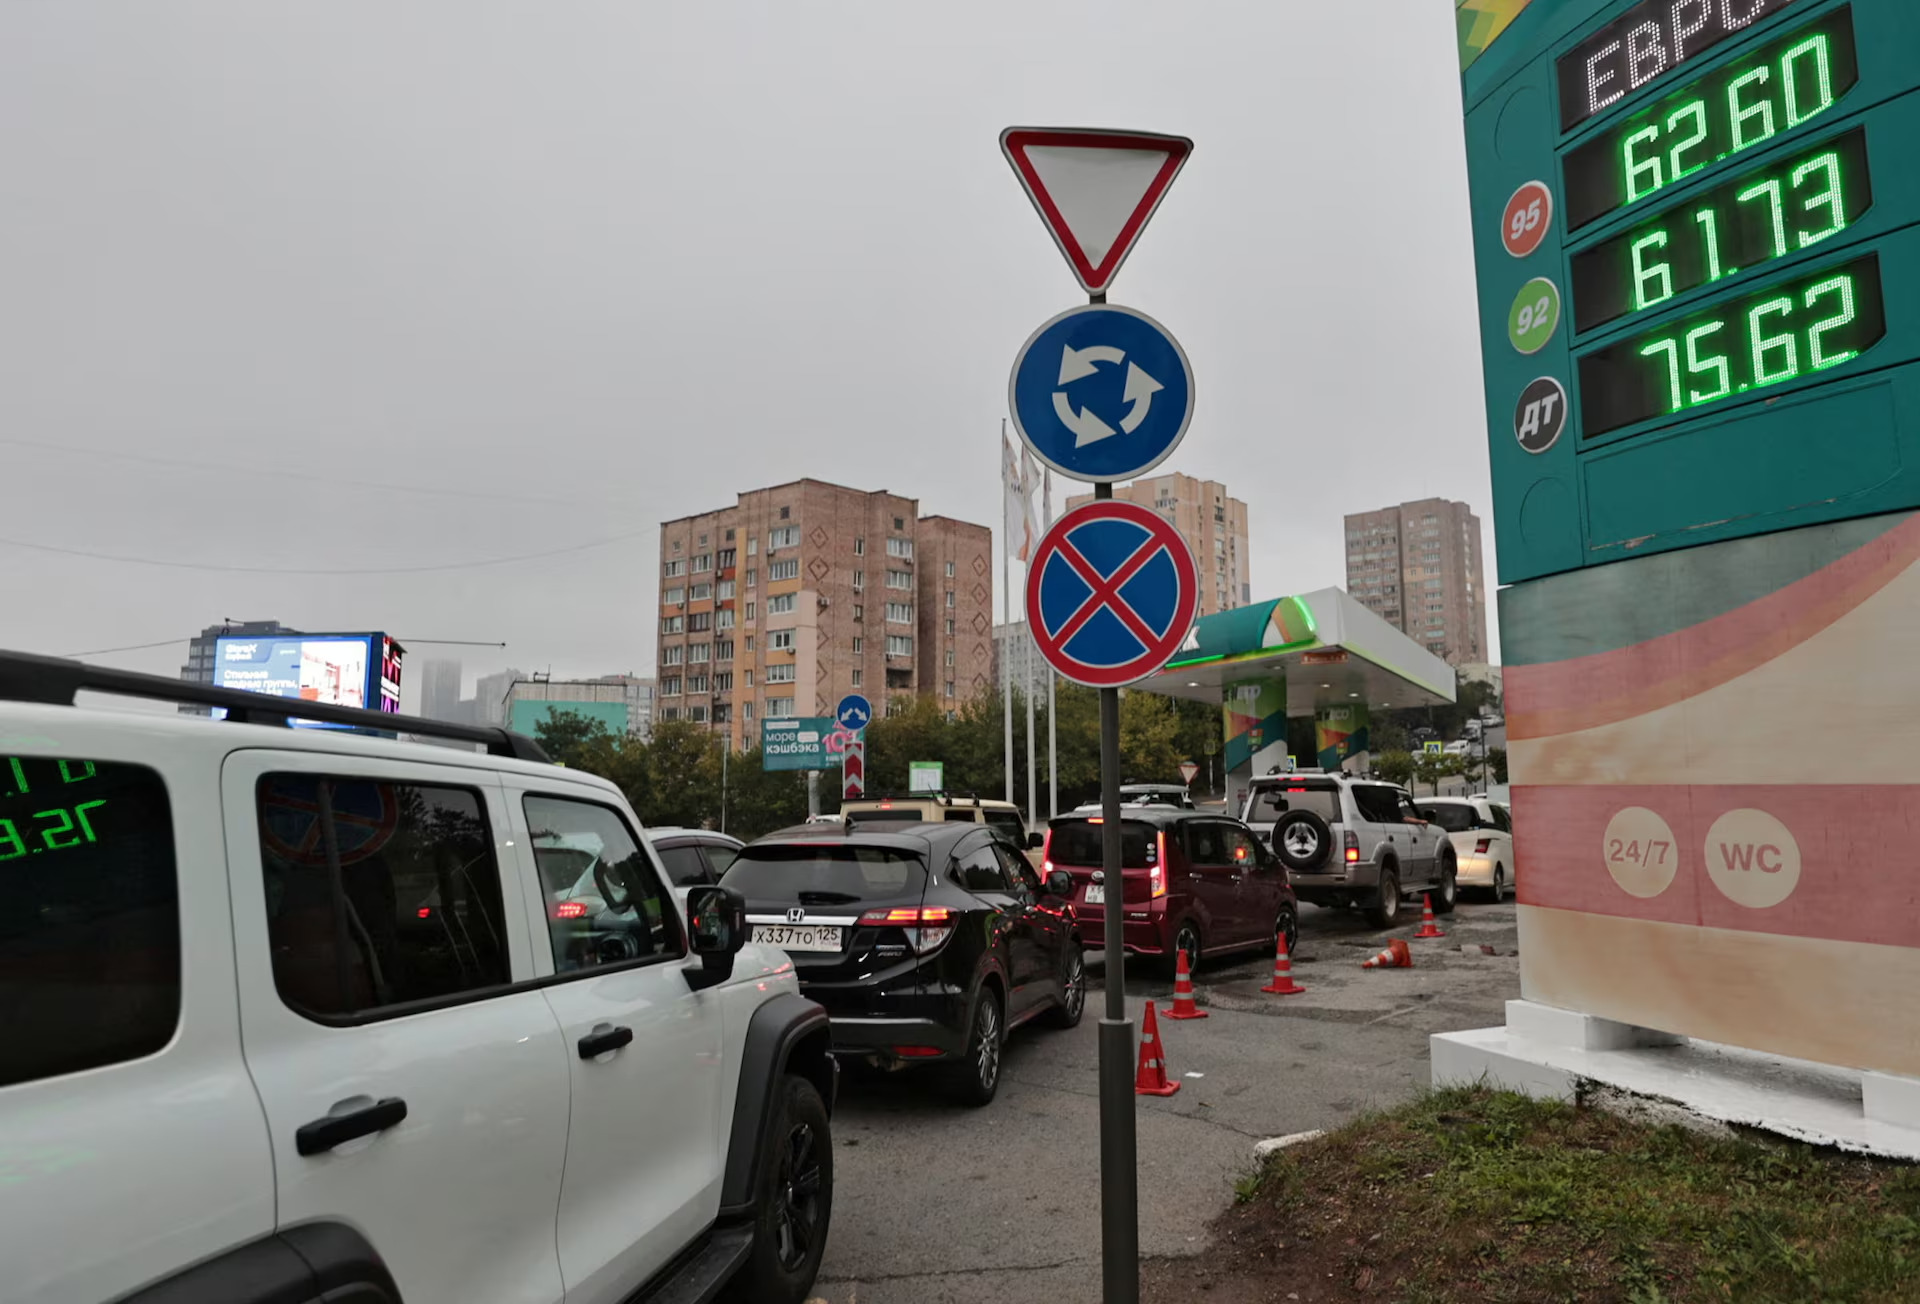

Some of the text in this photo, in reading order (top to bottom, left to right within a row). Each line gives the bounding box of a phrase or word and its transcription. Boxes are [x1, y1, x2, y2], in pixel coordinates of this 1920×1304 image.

[1624, 34, 1833, 203] 62.60
[1511, 198, 1541, 240] 95
[1630, 152, 1846, 310] 61.73
[1516, 296, 1549, 336] 92
[1640, 275, 1858, 412] 75.62
[1518, 391, 1560, 441] ДТ
[766, 732, 796, 746] море
[766, 742, 819, 754] кэшбэка
[1609, 839, 1670, 868] 24/7
[1720, 843, 1783, 874] WC
[756, 928, 838, 944] Х337ТО 125
